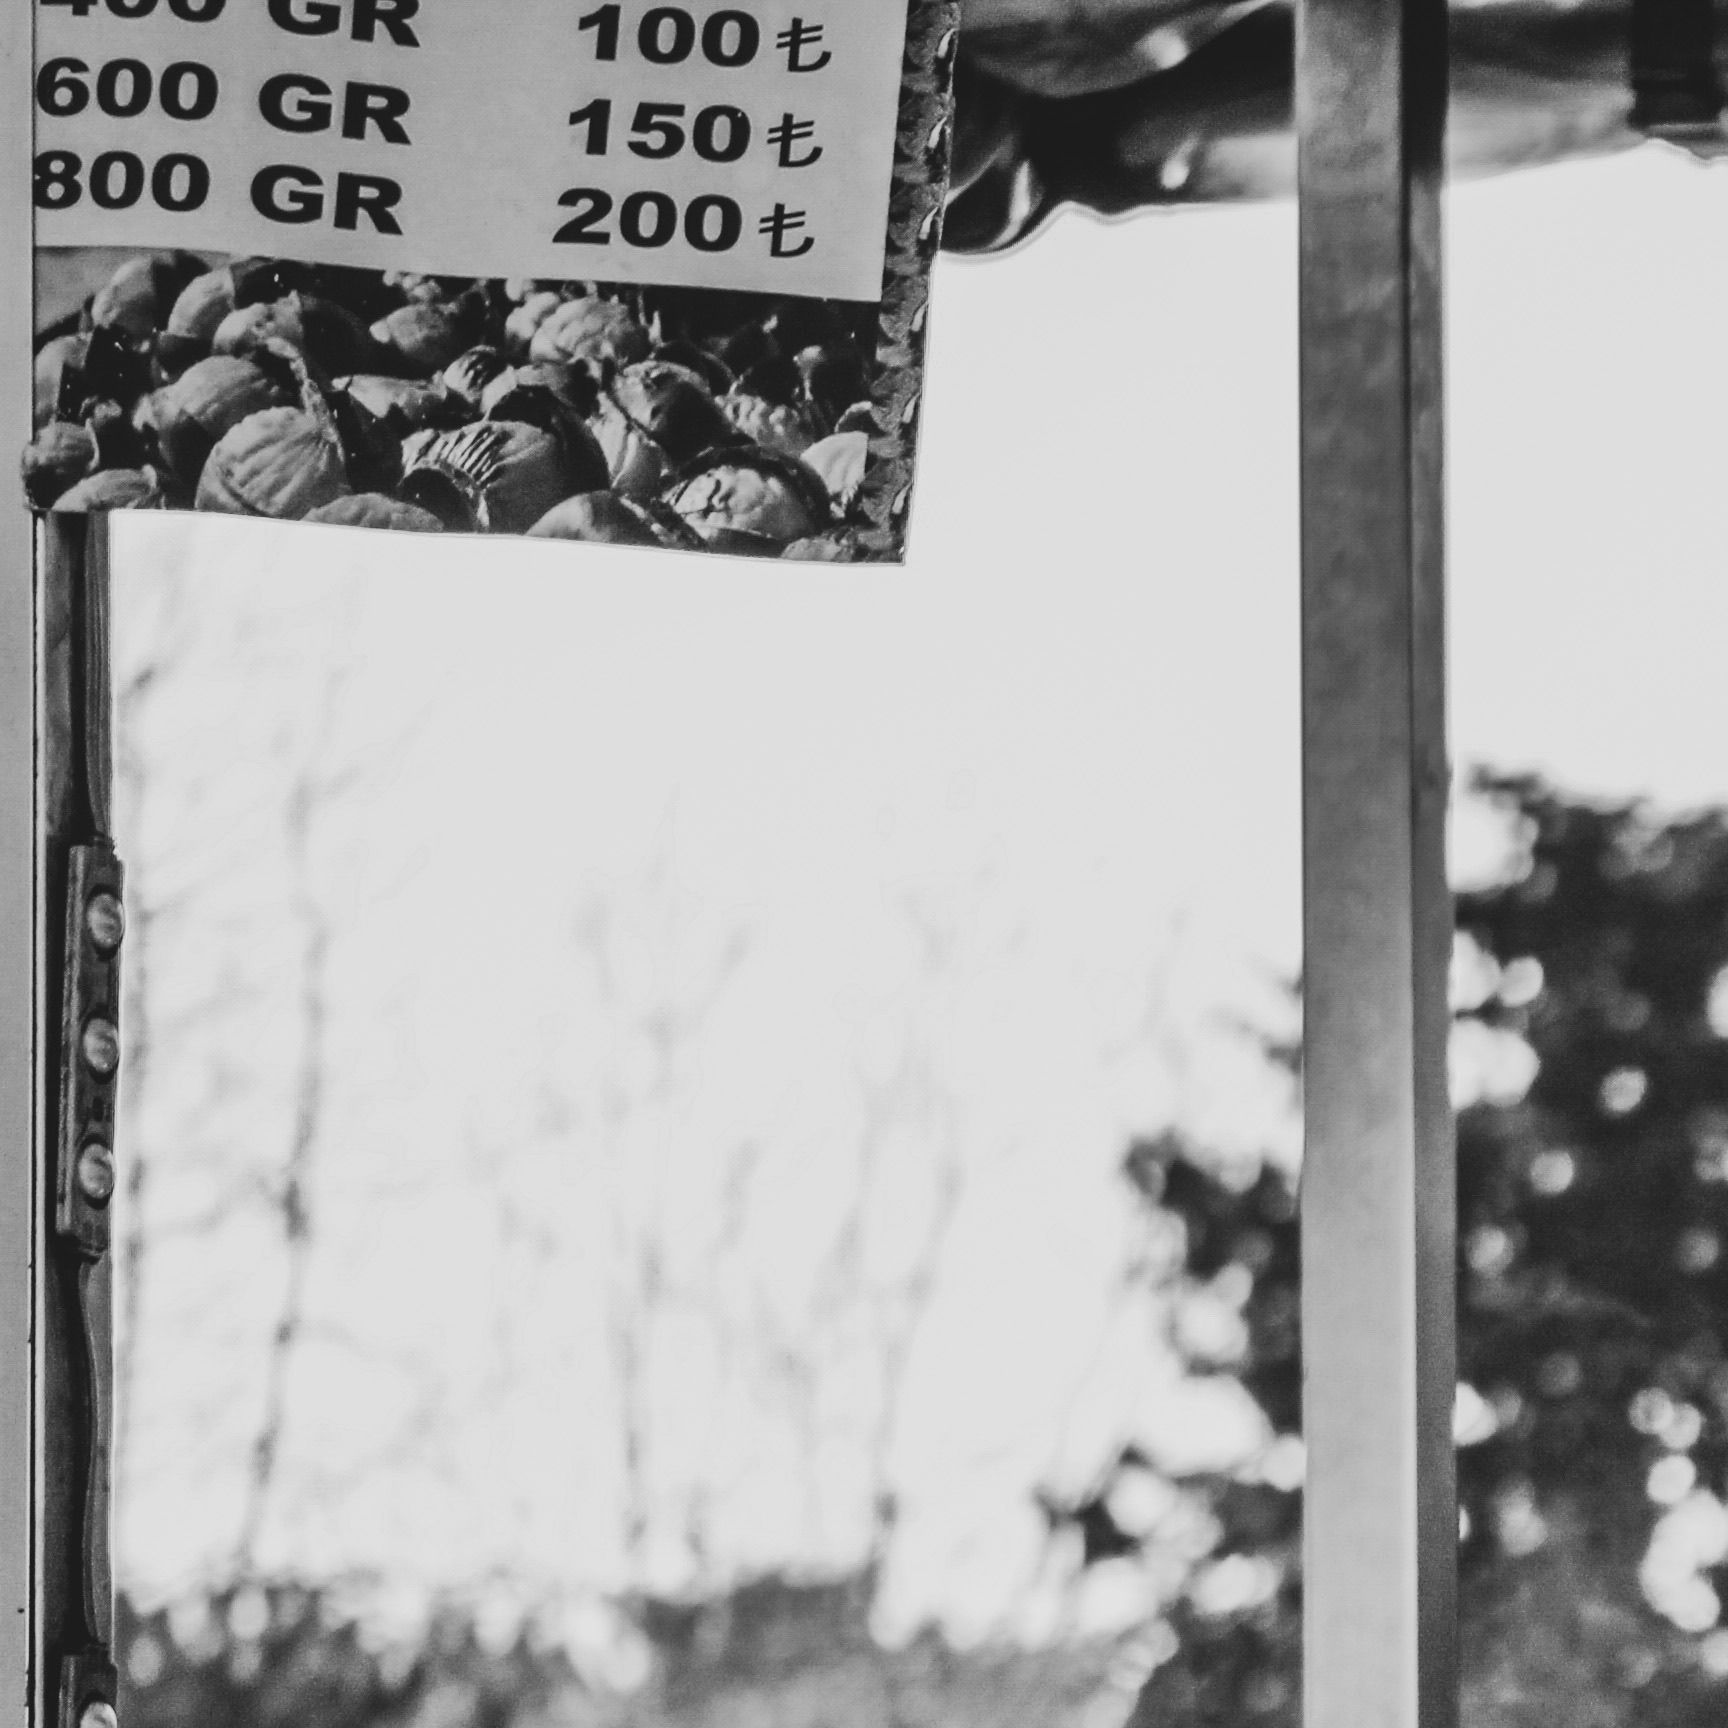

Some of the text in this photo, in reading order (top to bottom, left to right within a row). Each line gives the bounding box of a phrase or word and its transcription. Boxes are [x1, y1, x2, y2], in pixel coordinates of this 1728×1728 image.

[268, 0, 420, 48] GR
[36, 56, 219, 121] 600
[259, 73, 411, 145] GR
[33, 149, 210, 212] 800
[250, 164, 403, 236] GR
